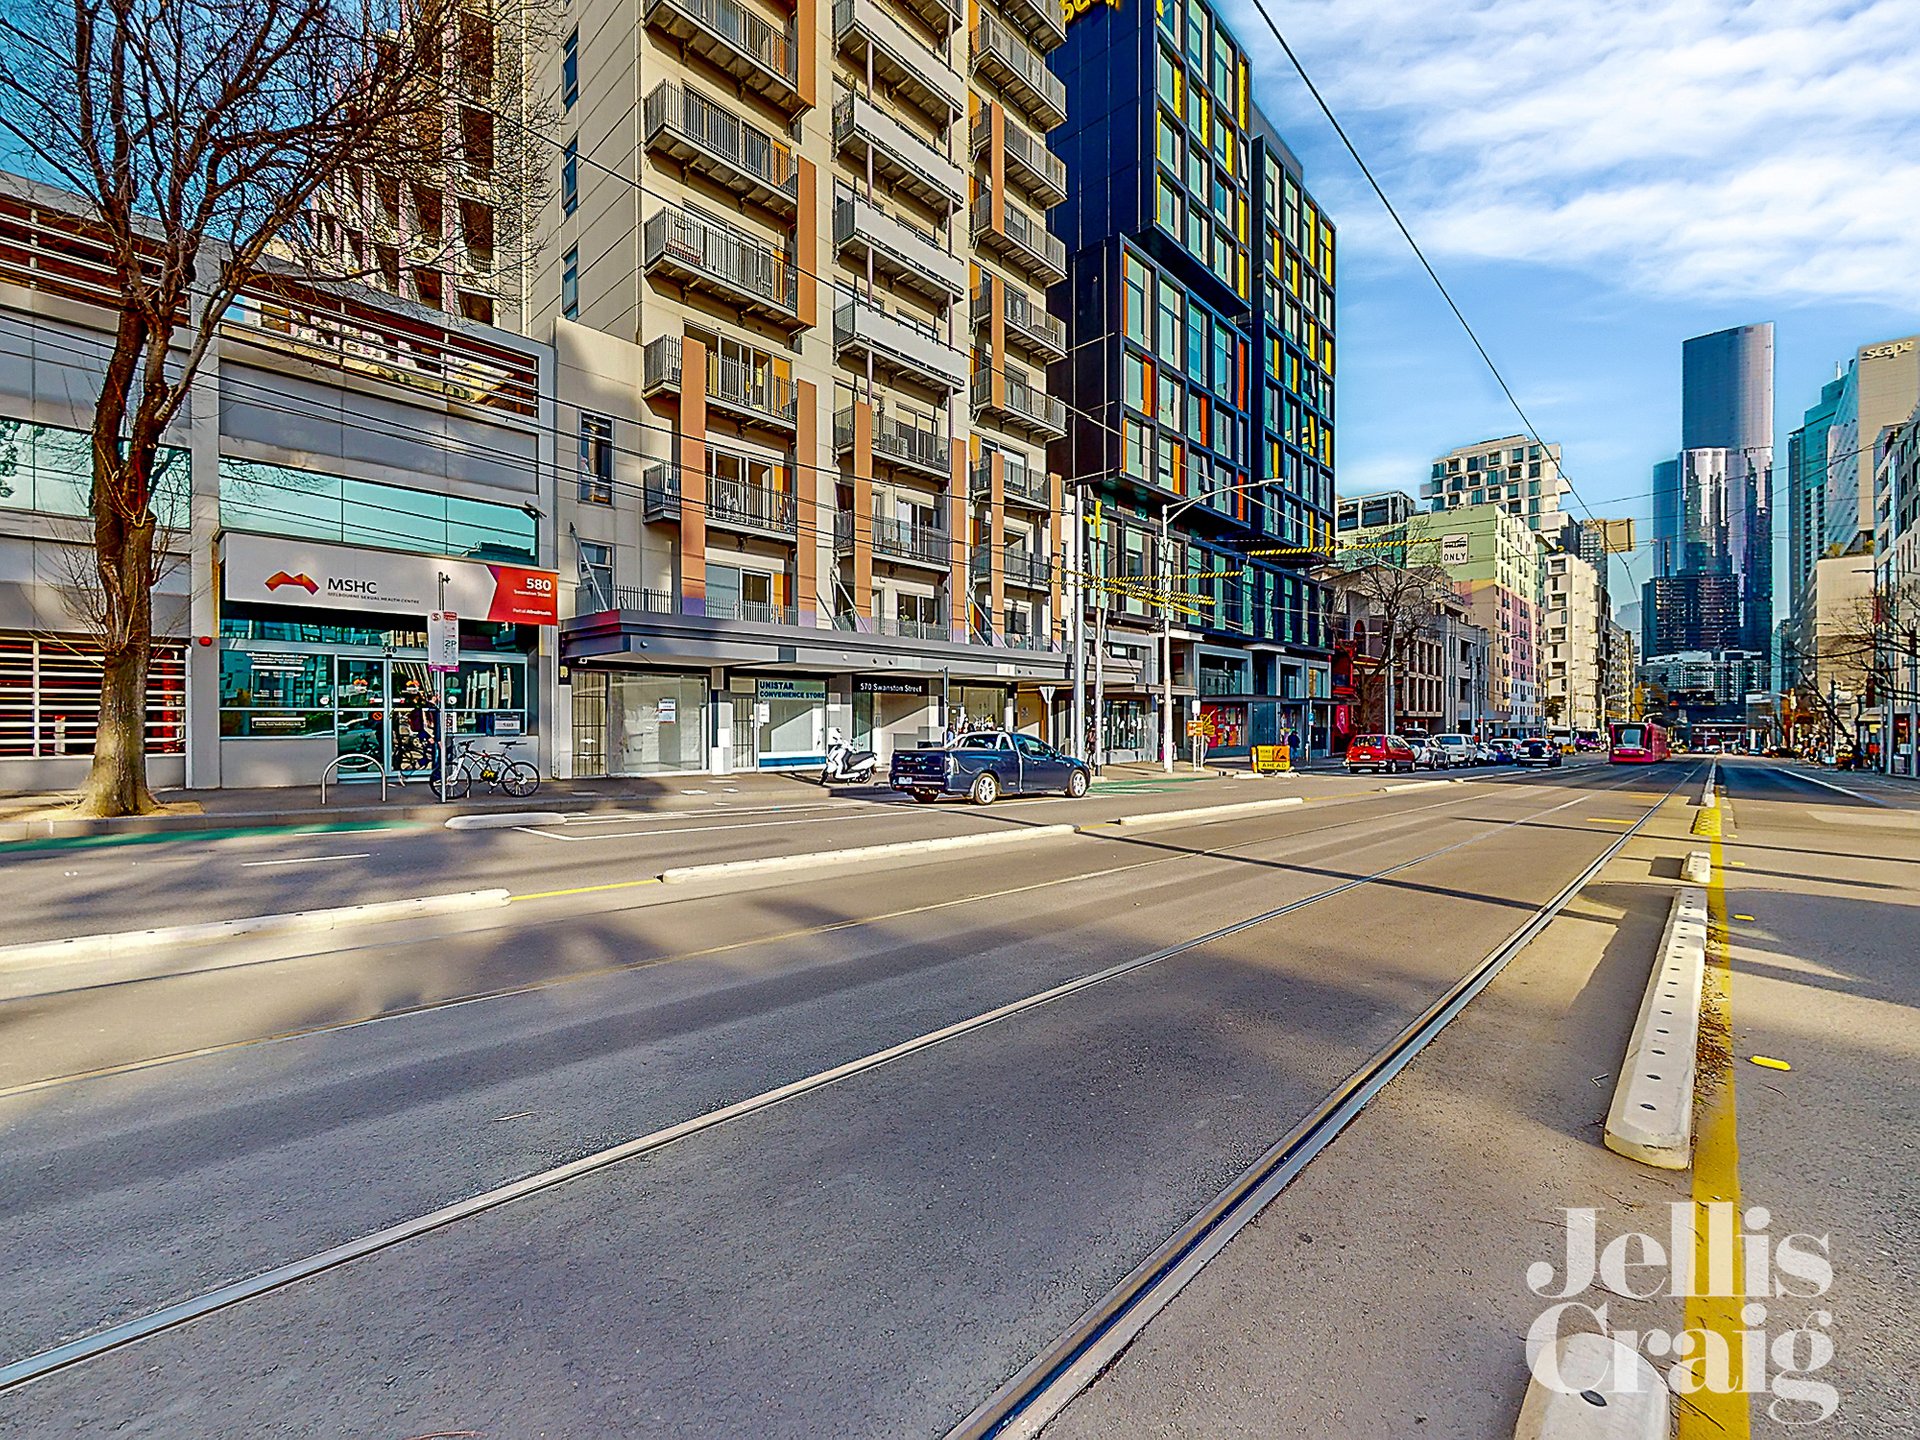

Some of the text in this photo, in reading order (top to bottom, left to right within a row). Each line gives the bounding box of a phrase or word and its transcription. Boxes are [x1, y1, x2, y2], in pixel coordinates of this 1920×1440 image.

[1862, 341, 1914, 359] scape
[1444, 552, 1466, 562] ONLY
[327, 577, 377, 594] MSHC
[526, 577, 552, 591] 580
[327, 591, 360, 599] MELBOURNE
[445, 639, 457, 648] 2P
[760, 681, 794, 690] UNISTAR
[860, 682, 922, 693] 570 Swanston Street
[760, 691, 804, 699] CONVENIENCE
